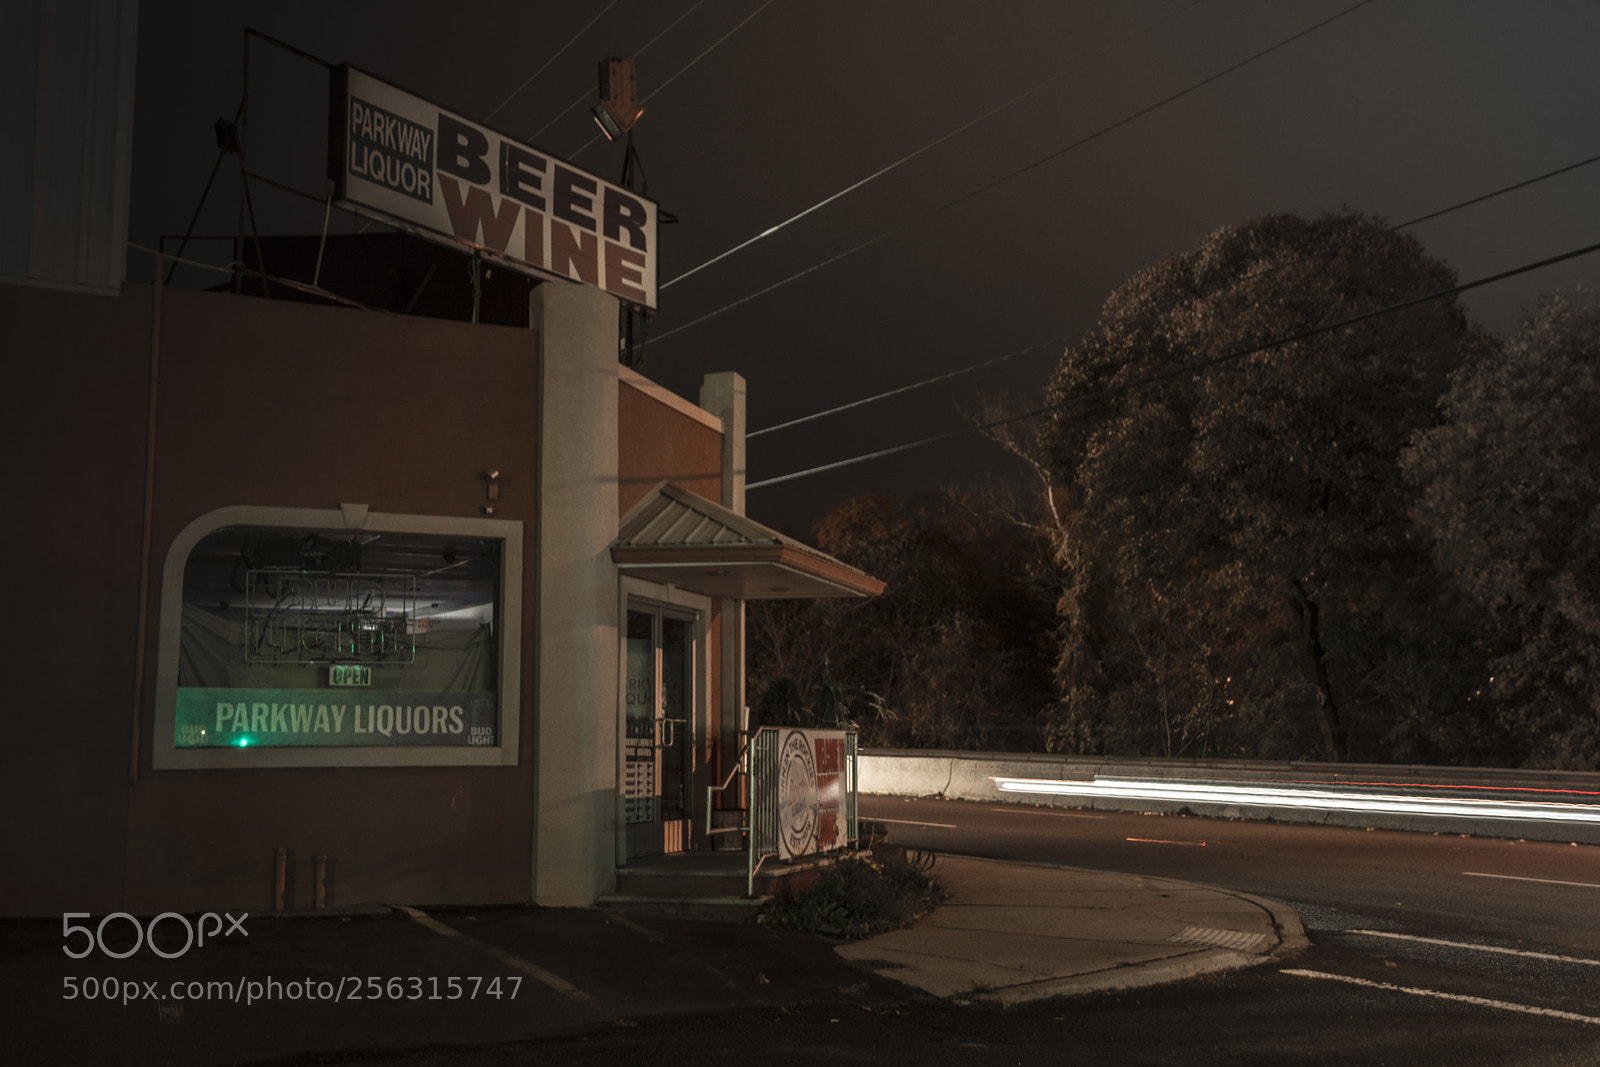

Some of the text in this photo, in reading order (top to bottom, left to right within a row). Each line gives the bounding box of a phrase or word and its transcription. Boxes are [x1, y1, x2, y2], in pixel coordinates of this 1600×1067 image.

[351, 102, 432, 162] PARKWAY
[350, 141, 432, 199] LIQUOR
[437, 112, 648, 253] BEER
[437, 172, 647, 303] WINE
[333, 667, 369, 685] OPEN
[215, 702, 464, 738] PARKWAY LIQUORS
[470, 726, 492, 736] BUD
[177, 734, 208, 745] LIGHT
[467, 735, 495, 745] LIGHT
